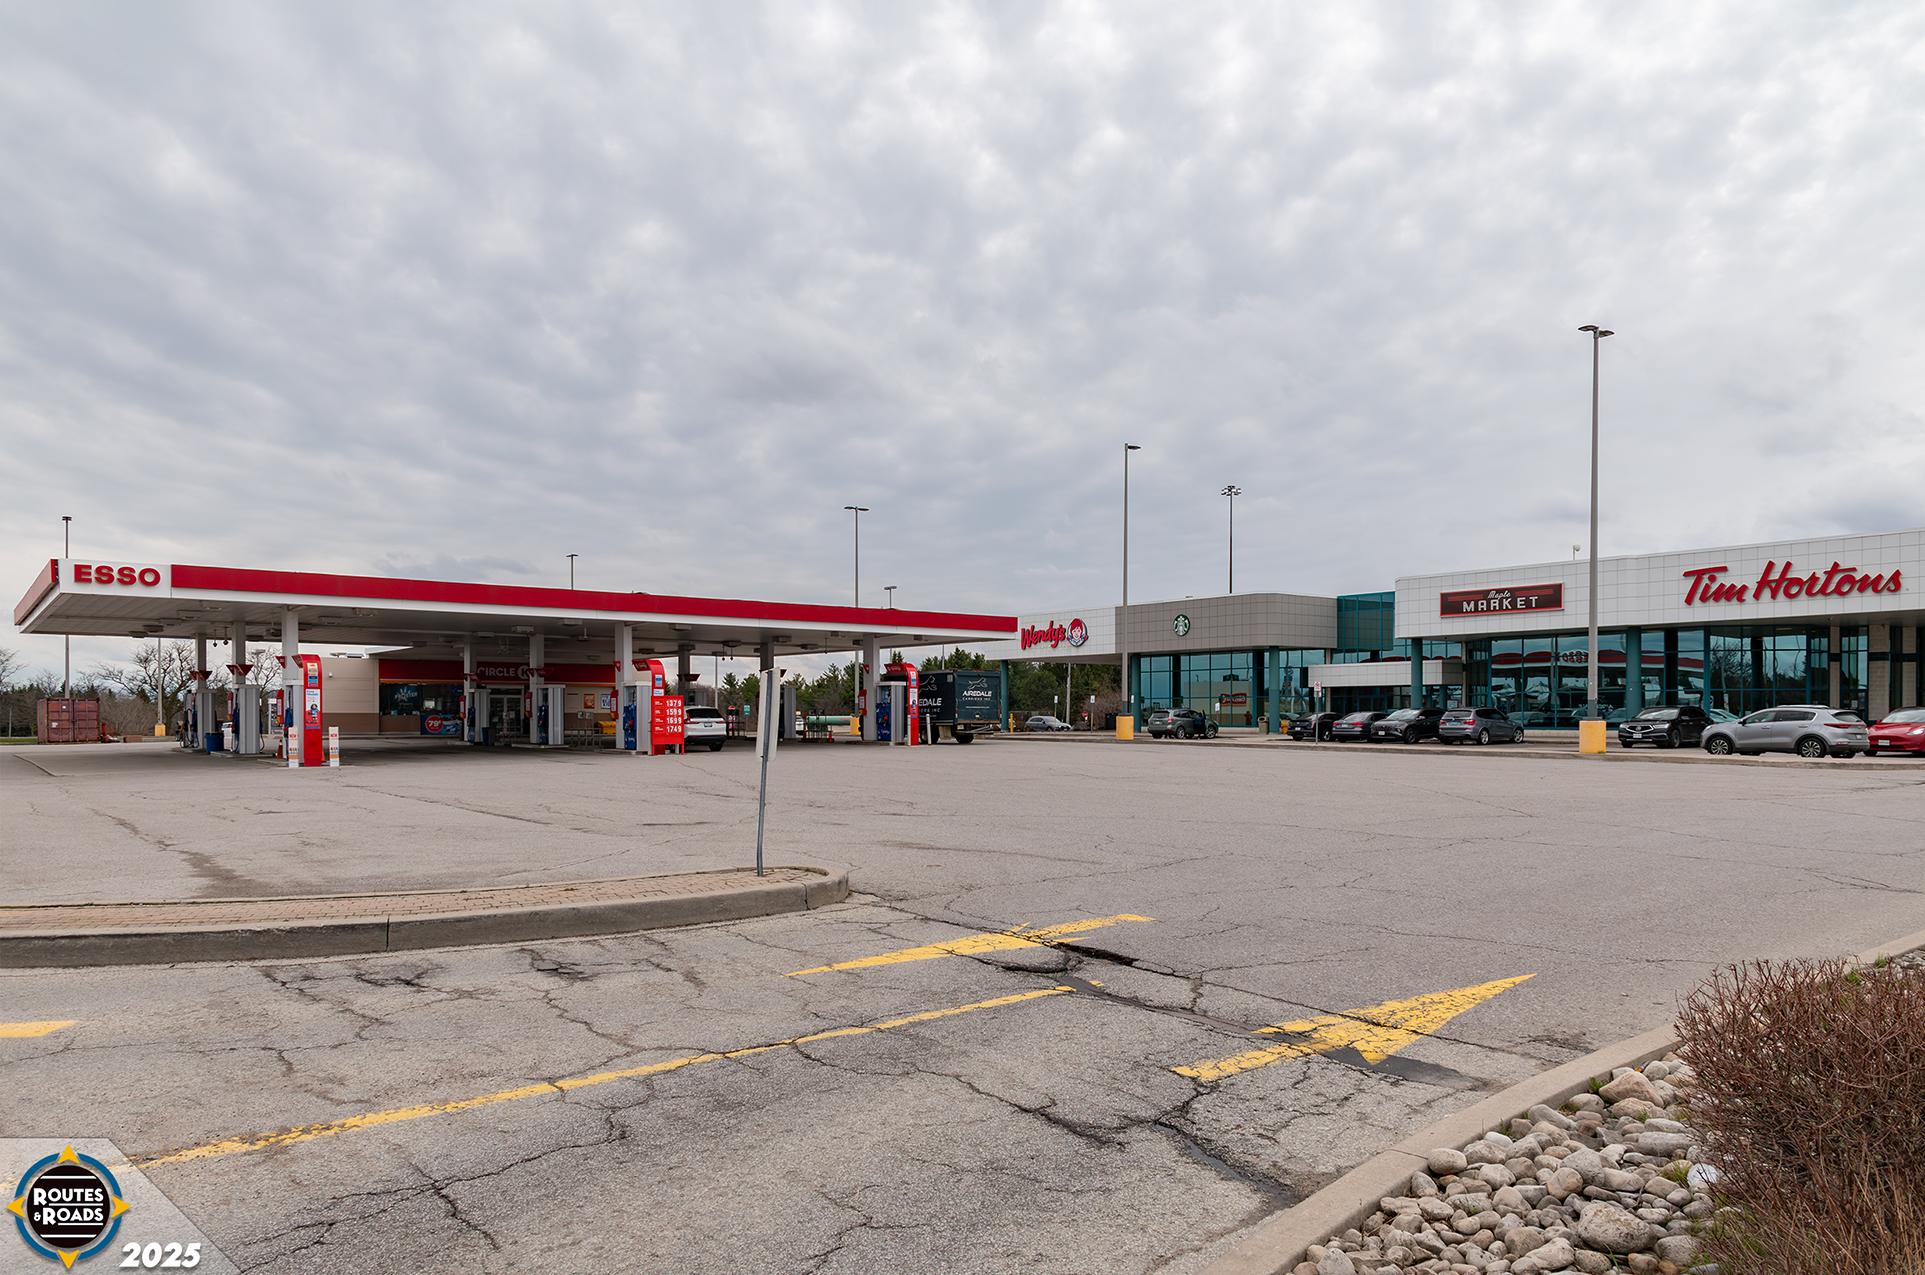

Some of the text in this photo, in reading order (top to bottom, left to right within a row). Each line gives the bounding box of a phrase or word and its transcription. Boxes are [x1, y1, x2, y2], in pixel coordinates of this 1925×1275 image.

[74, 564, 161, 587] ESSO
[1683, 560, 1902, 605] Tim Hortons
[1463, 597, 1538, 612] MARKET
[1487, 590, 1511, 600] Maple
[1021, 620, 1067, 650] Wendy's
[919, 698, 942, 706] EDALE
